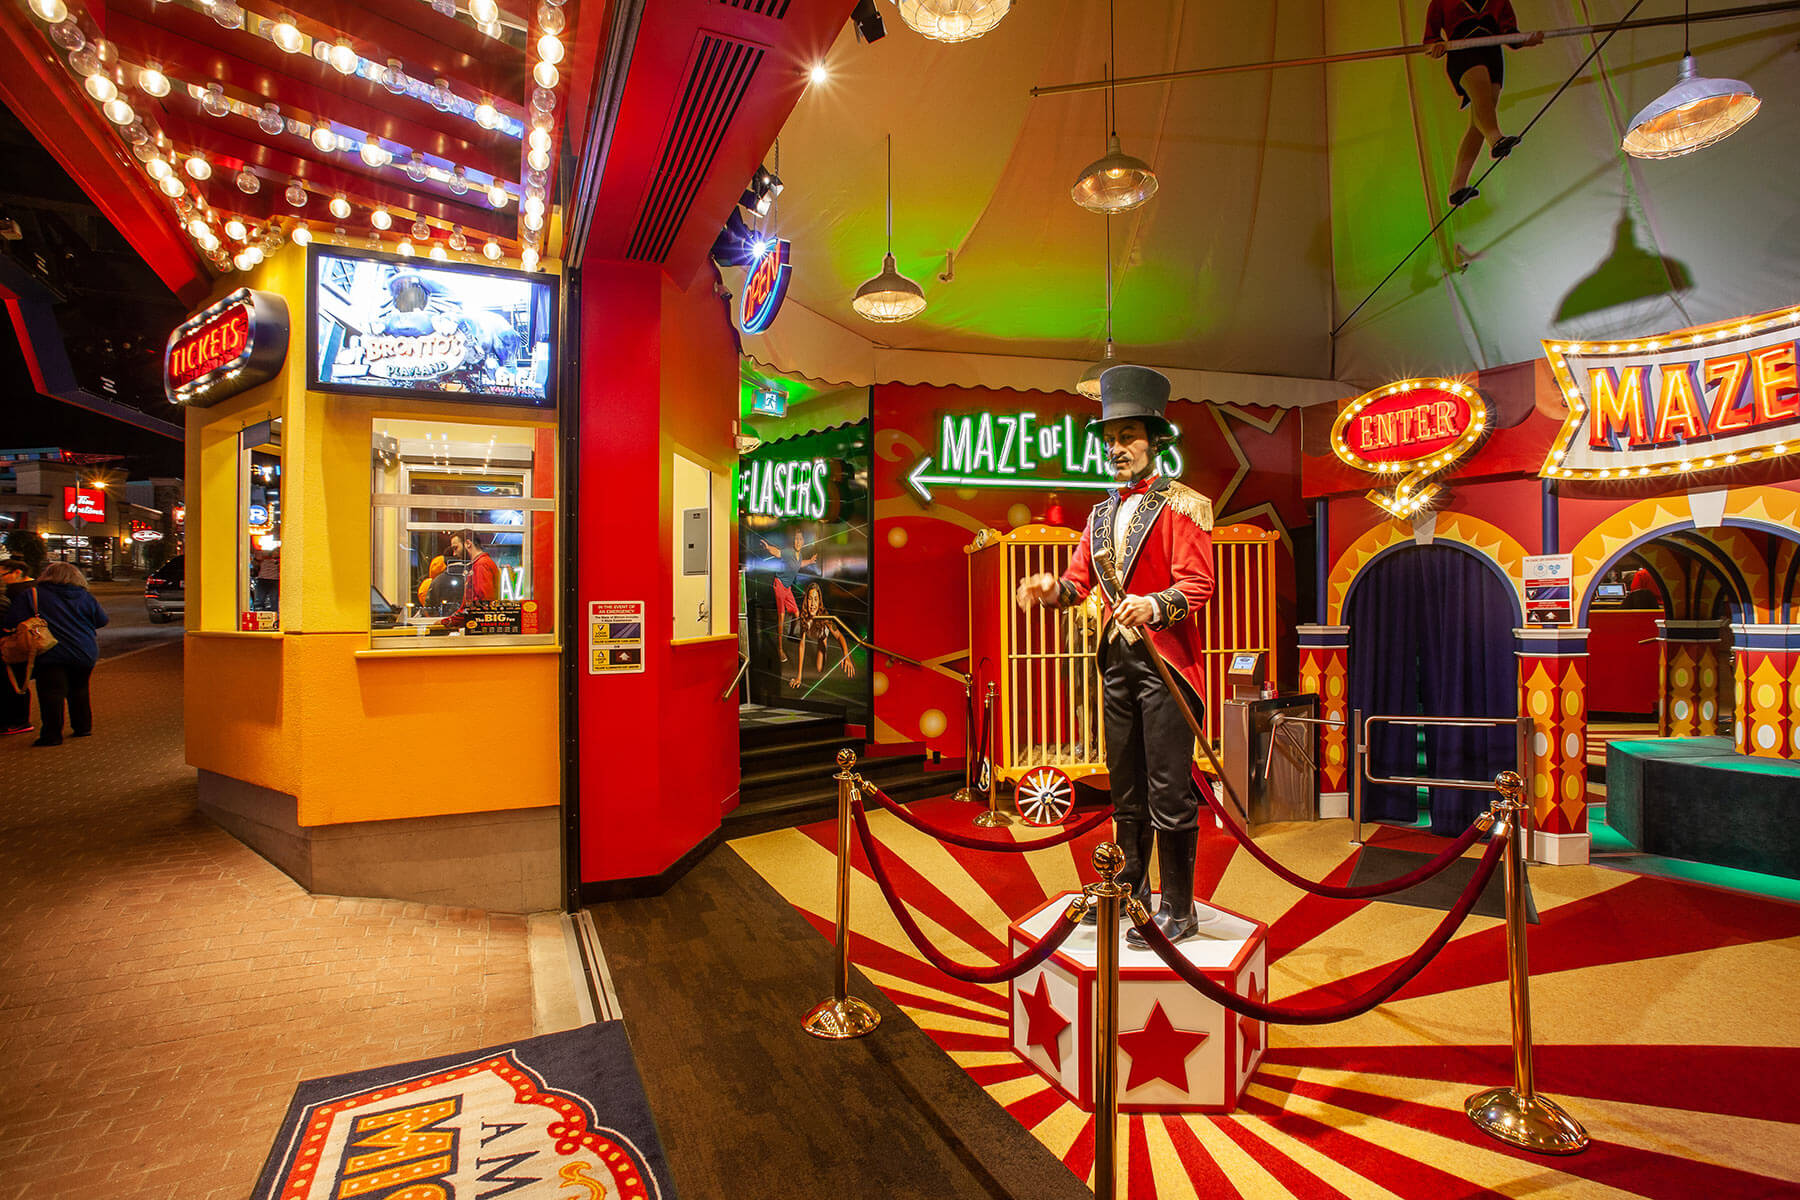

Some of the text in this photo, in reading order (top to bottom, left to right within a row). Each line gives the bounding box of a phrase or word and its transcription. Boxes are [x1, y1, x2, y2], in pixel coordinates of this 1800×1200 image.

[743, 238, 782, 325] OPEN
[172, 317, 241, 377] TICKETS
[365, 335, 463, 362] BRONTO'S
[386, 360, 449, 378] PLAYLAND
[1587, 340, 1800, 452] MAZE
[941, 411, 1184, 479] MAZE OF LAS
[1360, 400, 1459, 451] ENTER
[77, 495, 95, 506] Tim
[749, 458, 828, 520] LASERS
[484, 613, 506, 622] BIG
